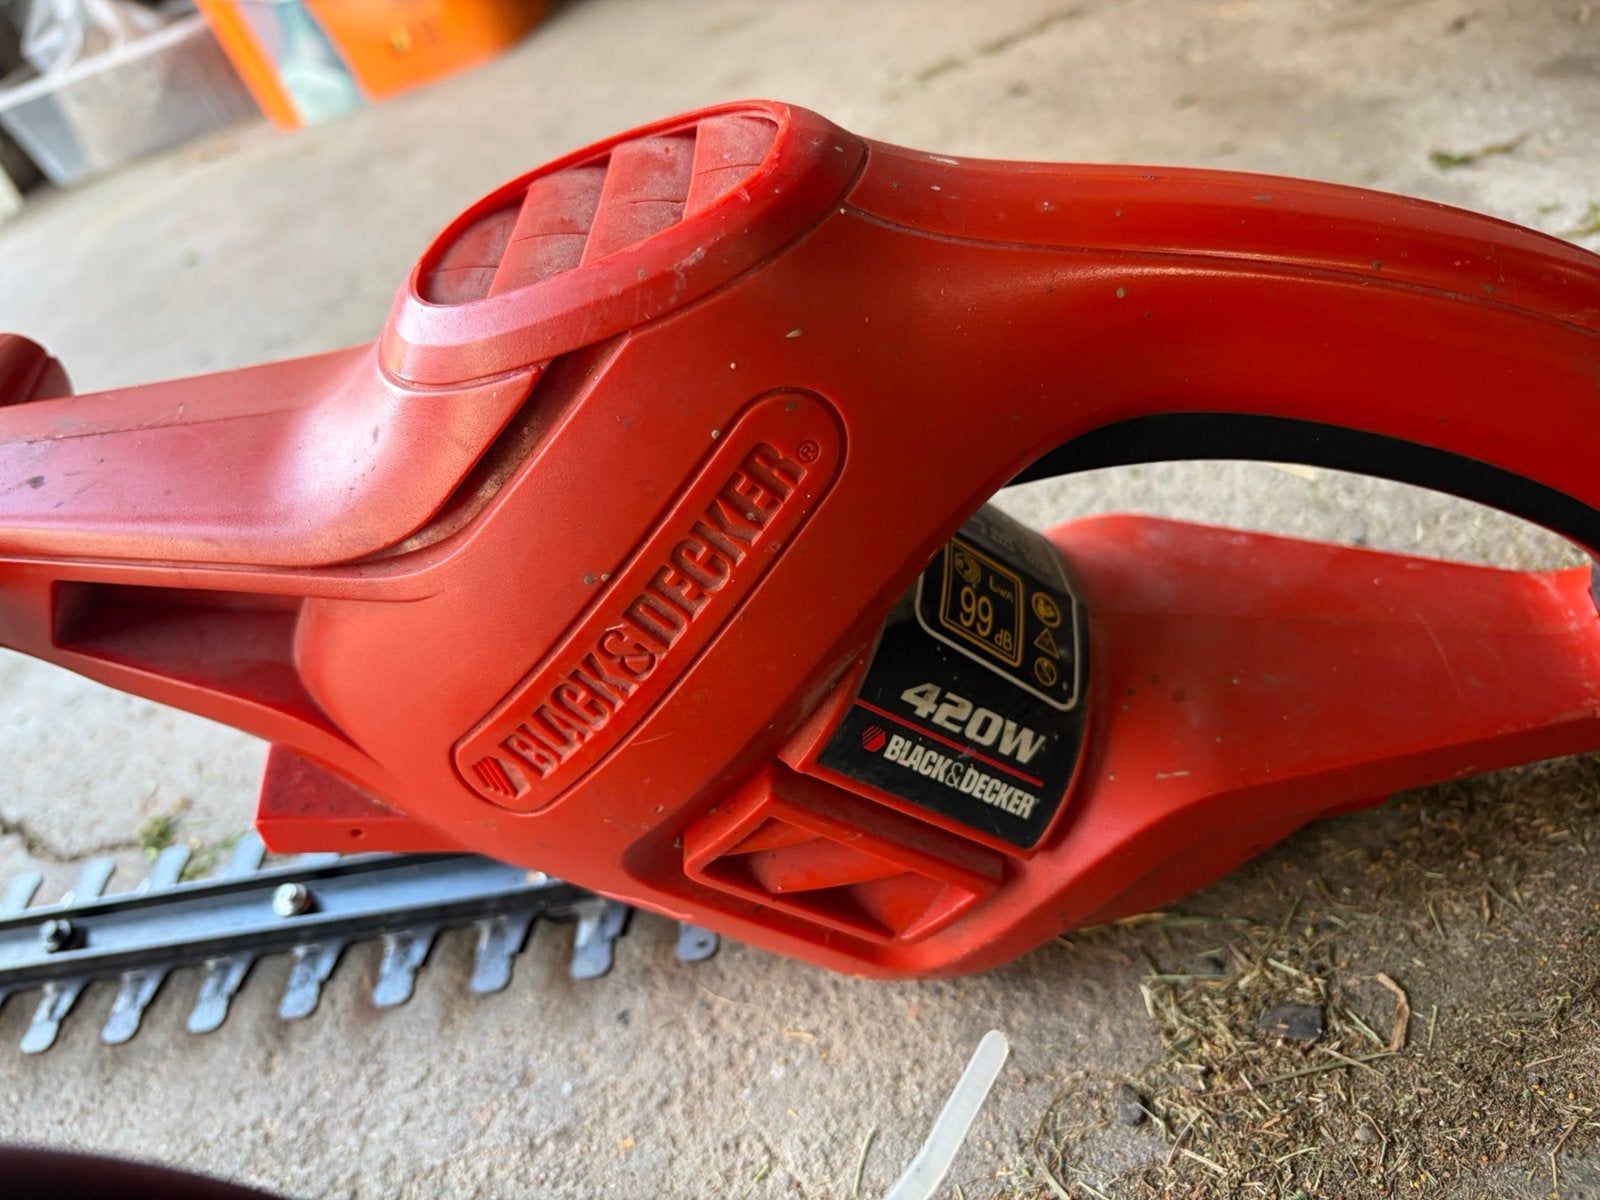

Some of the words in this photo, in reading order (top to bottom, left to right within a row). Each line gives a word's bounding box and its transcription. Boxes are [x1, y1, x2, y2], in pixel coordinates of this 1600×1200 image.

[959, 585, 993, 637] 99
[994, 628, 1013, 651] dB
[900, 682, 1047, 764] 420W
